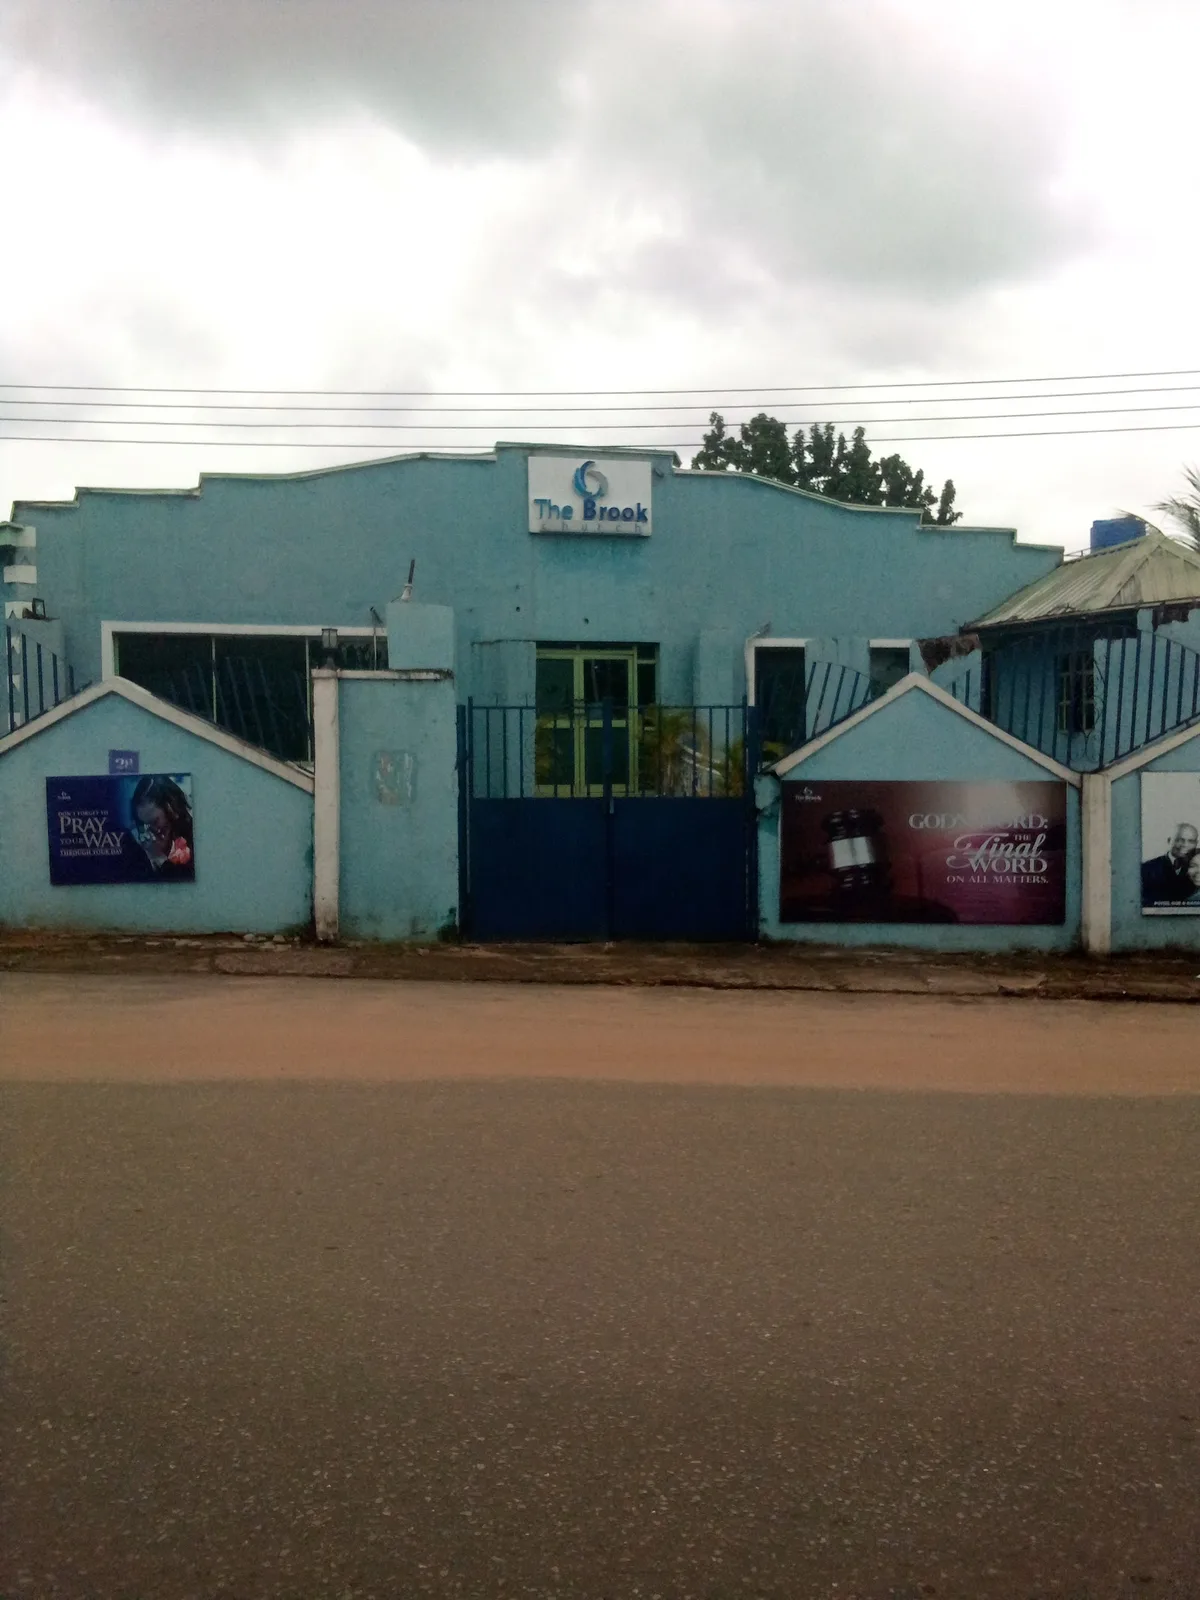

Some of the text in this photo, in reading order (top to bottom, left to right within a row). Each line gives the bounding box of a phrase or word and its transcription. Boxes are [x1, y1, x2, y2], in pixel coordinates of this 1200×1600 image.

[534, 499, 648, 522] The Brook
[60, 816, 107, 834] PRAY
[976, 813, 1048, 829] ORD:
[82, 832, 124, 847] WAY
[946, 833, 1046, 869] Final
[968, 857, 1048, 873] WORD
[946, 875, 965, 883] ON
[969, 875, 988, 883] ALL
